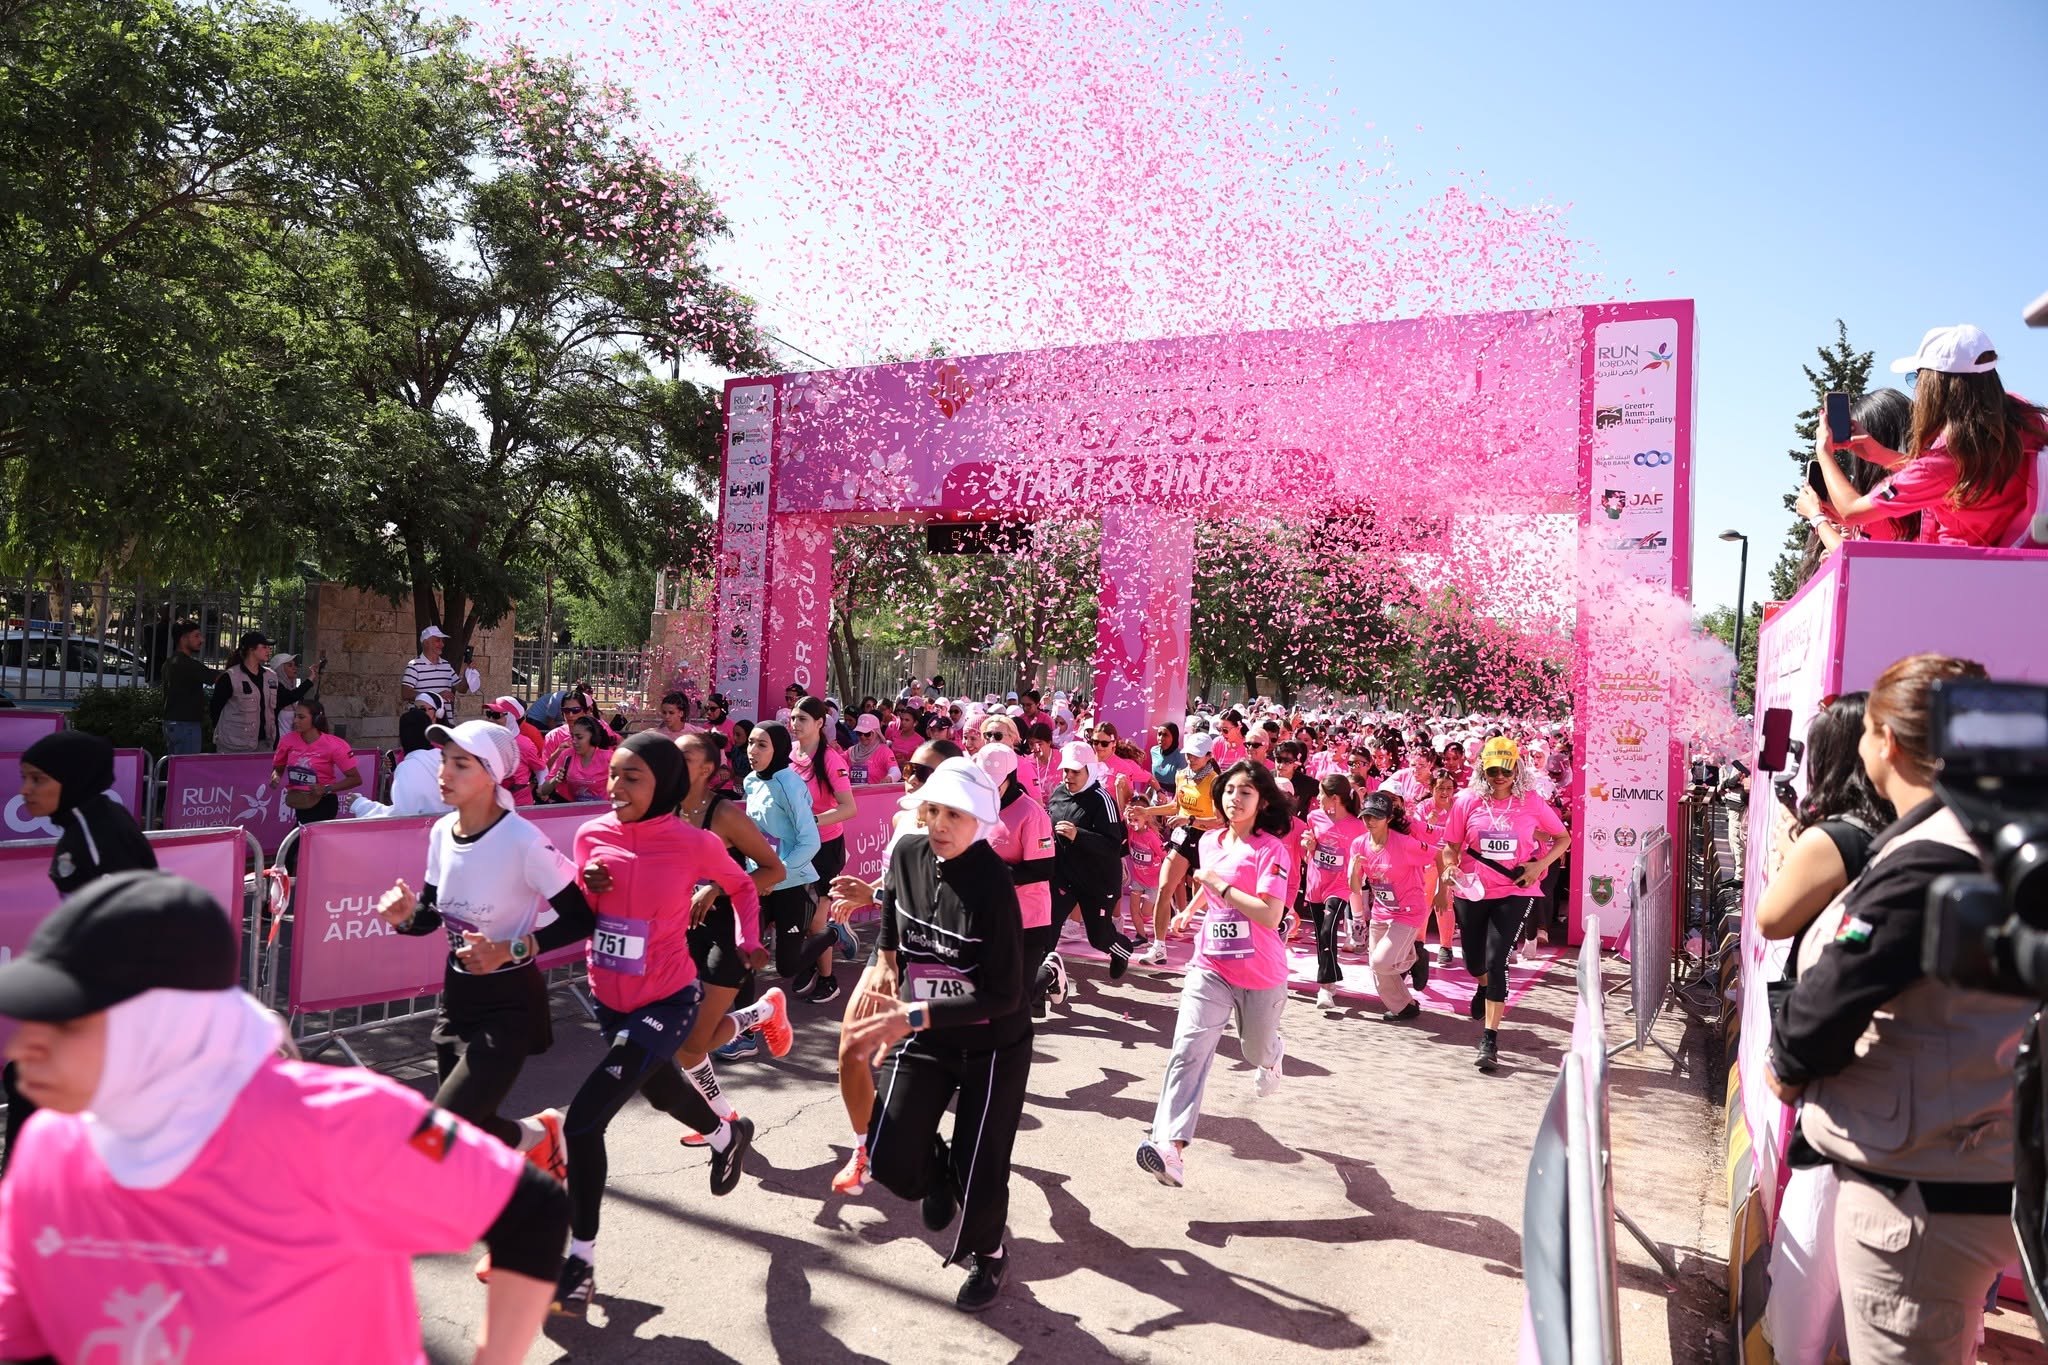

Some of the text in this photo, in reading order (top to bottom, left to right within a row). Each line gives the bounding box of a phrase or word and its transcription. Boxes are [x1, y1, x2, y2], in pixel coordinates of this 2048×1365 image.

[1598, 344, 1639, 360] RUN
[1599, 359, 1639, 368] JORDAN
[733, 395, 754, 405] RUN
[1624, 402, 1655, 410] Greater
[1110, 461, 1136, 496] &
[1630, 493, 1664, 506] JAF
[797, 559, 816, 629] YOU
[182, 786, 234, 805] RUN
[1612, 788, 1664, 801] GIMMICK
[182, 805, 231, 817] JORDAN
[857, 819, 890, 855] الأردن
[1488, 840, 1510, 851] 406
[1320, 853, 1337, 865] 542
[858, 859, 882, 876] JORD
[1212, 922, 1238, 939] 663
[598, 932, 627, 956] 751
[926, 980, 965, 998] 748
[642, 1016, 664, 1032] JAKO
[691, 1063, 721, 1101] MARVEL
